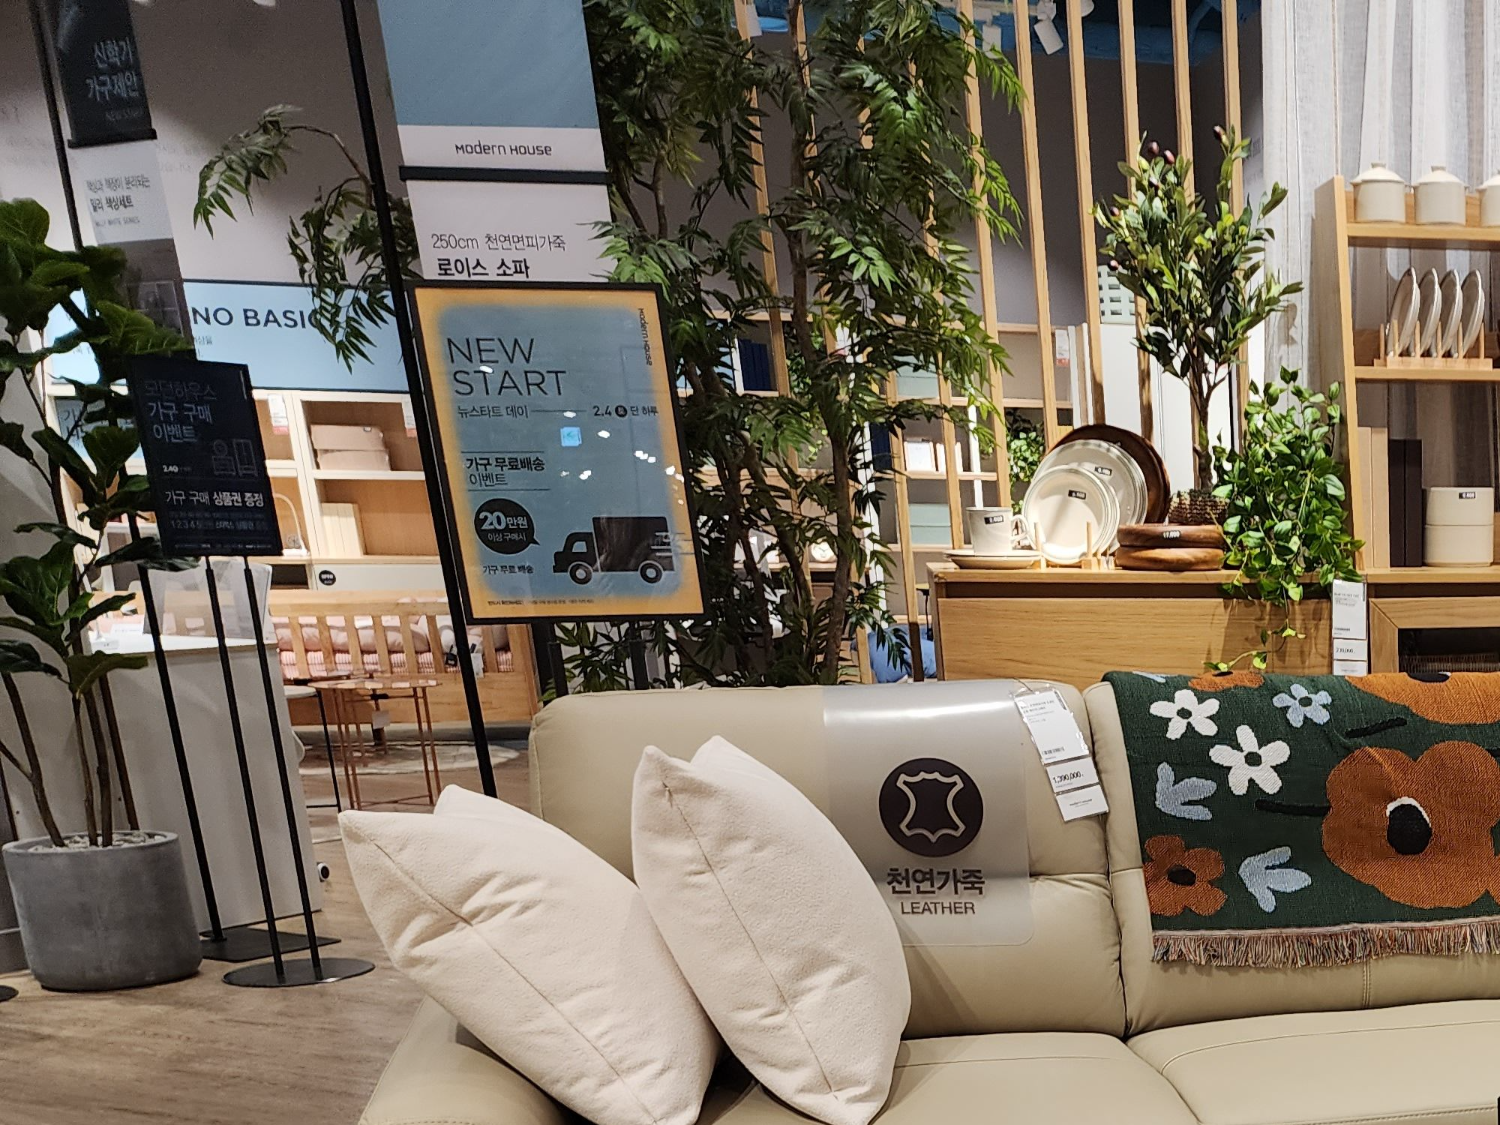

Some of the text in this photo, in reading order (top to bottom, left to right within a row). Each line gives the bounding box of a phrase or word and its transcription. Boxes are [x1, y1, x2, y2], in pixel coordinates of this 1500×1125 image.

[86, 70, 140, 101] 가구제안
[431, 233, 566, 251] 250cm 천연면피가죽
[437, 257, 530, 278] 로이스 소파
[447, 337, 535, 364] NEW
[453, 370, 566, 396] START
[149, 402, 213, 424] 가구 구매
[457, 405, 529, 419] 뉴스타트 데이
[593, 405, 659, 417] 2.4 단 하루
[153, 424, 197, 443] 이벤트
[466, 457, 545, 472] 가구 무료배송
[469, 472, 508, 487] 이벤트
[165, 491, 186, 506] 가구
[189, 491, 210, 506] 구매
[213, 491, 242, 507] 상품권
[479, 511, 528, 530] 20만원
[487, 532, 502, 542] 이상
[482, 565, 499, 575] 가구
[517, 565, 534, 574] 배송
[886, 867, 986, 896] 천연가죽
[900, 901, 976, 915] LEATHER
